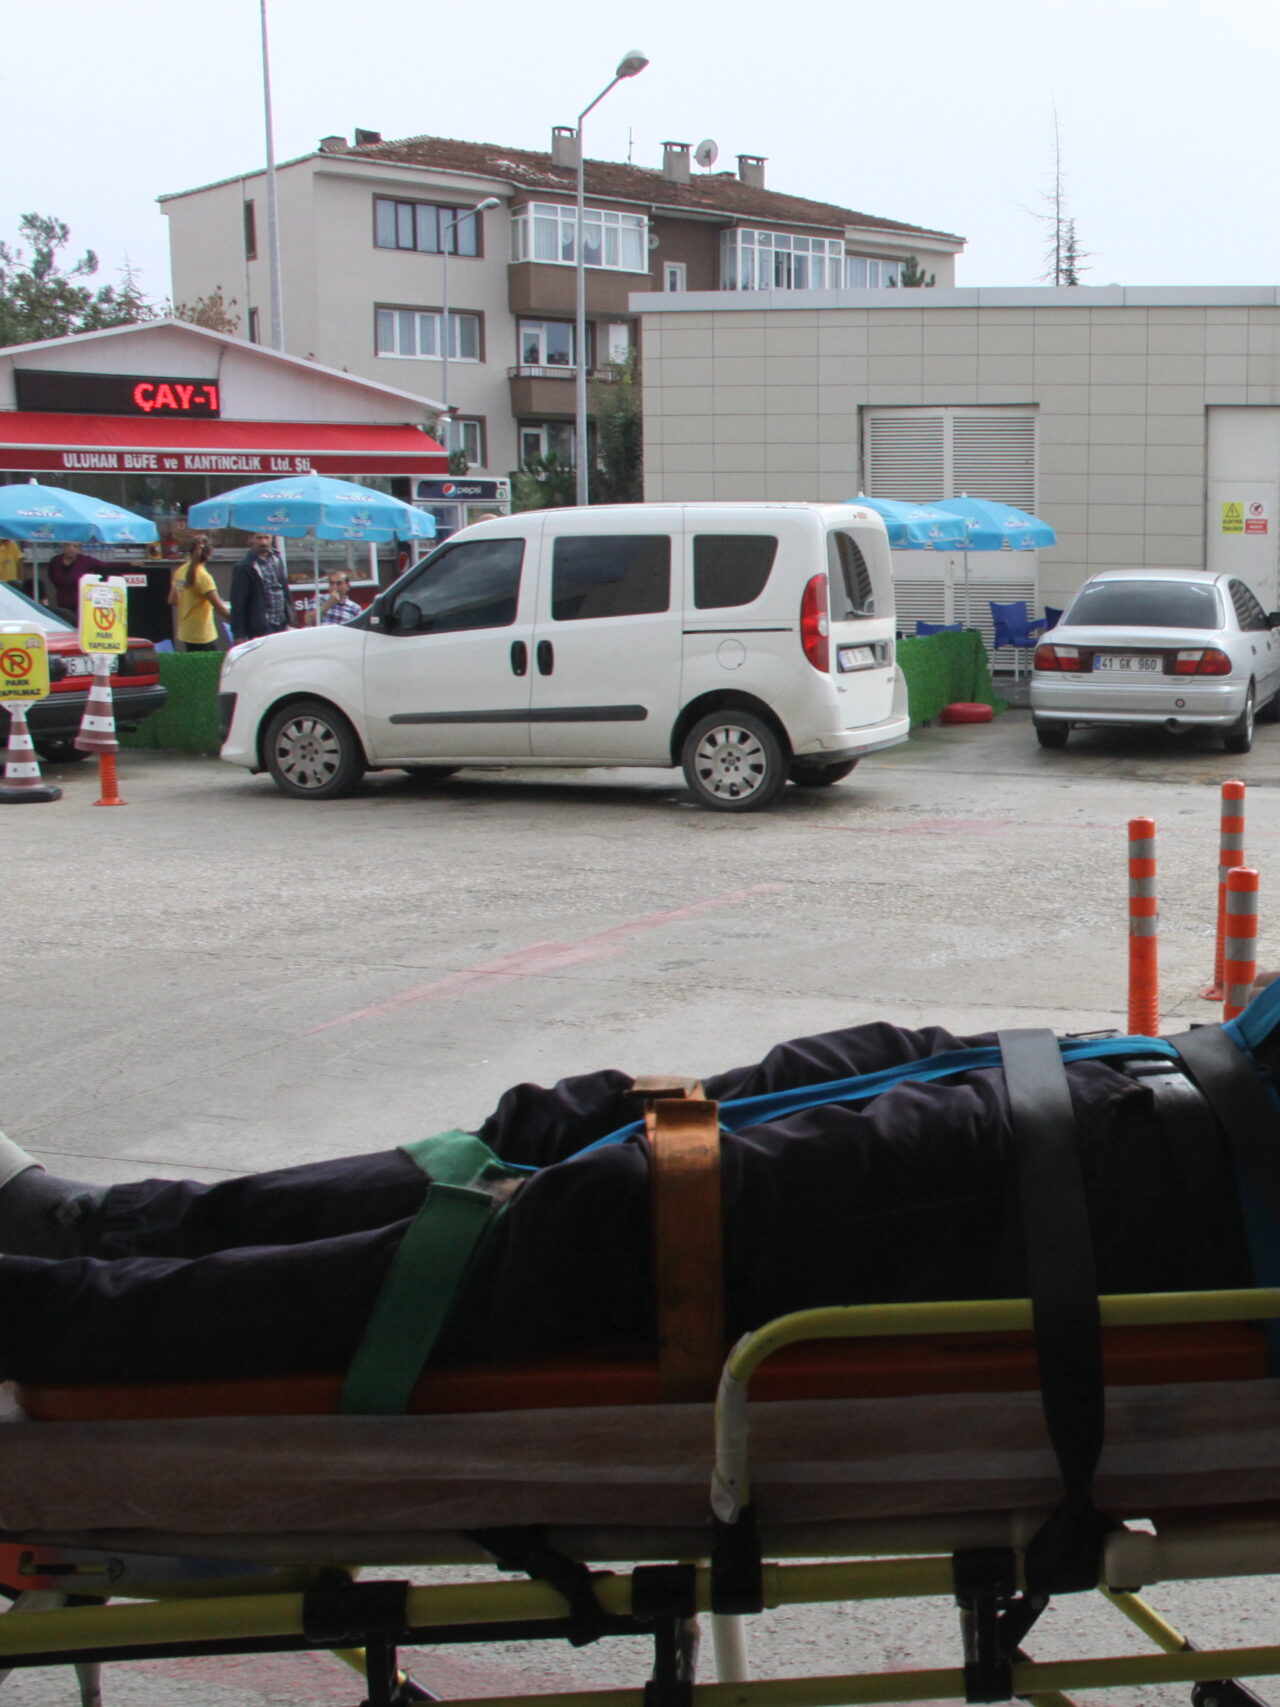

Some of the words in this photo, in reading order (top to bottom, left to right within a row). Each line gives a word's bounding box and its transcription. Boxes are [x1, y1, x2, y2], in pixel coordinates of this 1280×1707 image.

[63, 452, 118, 468] ULUHAN
[124, 454, 158, 469] BÜFE
[163, 458, 178, 469] ve
[270, 456, 292, 472] Ltd.
[457, 485, 482, 495] pepsi
[1102, 657, 1113, 669] 41
[1138, 658, 1157, 671] 960
[5, 679, 30, 687] PARK
